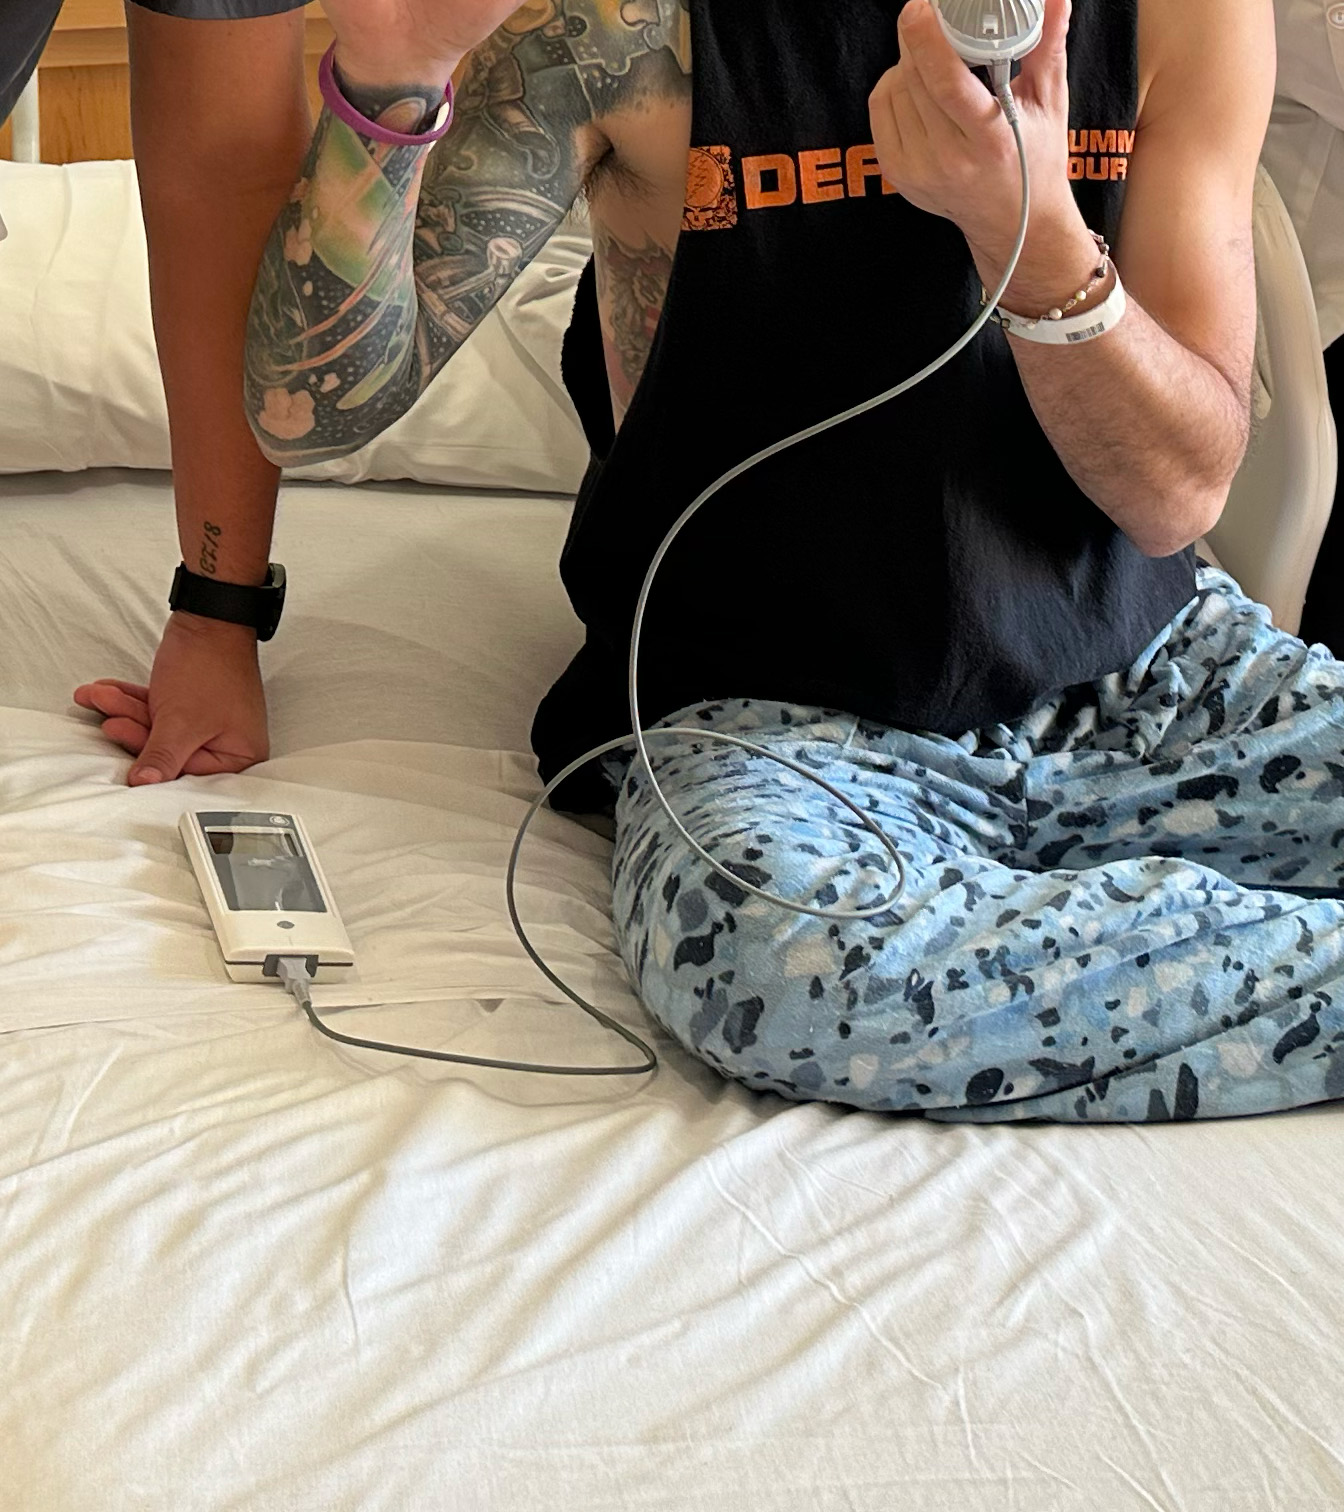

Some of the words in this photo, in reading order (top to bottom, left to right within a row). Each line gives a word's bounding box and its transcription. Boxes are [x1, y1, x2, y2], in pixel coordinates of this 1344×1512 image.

[1069, 129, 1136, 154] UMM
[741, 143, 900, 210] DEA
[1067, 156, 1128, 181] OUR
